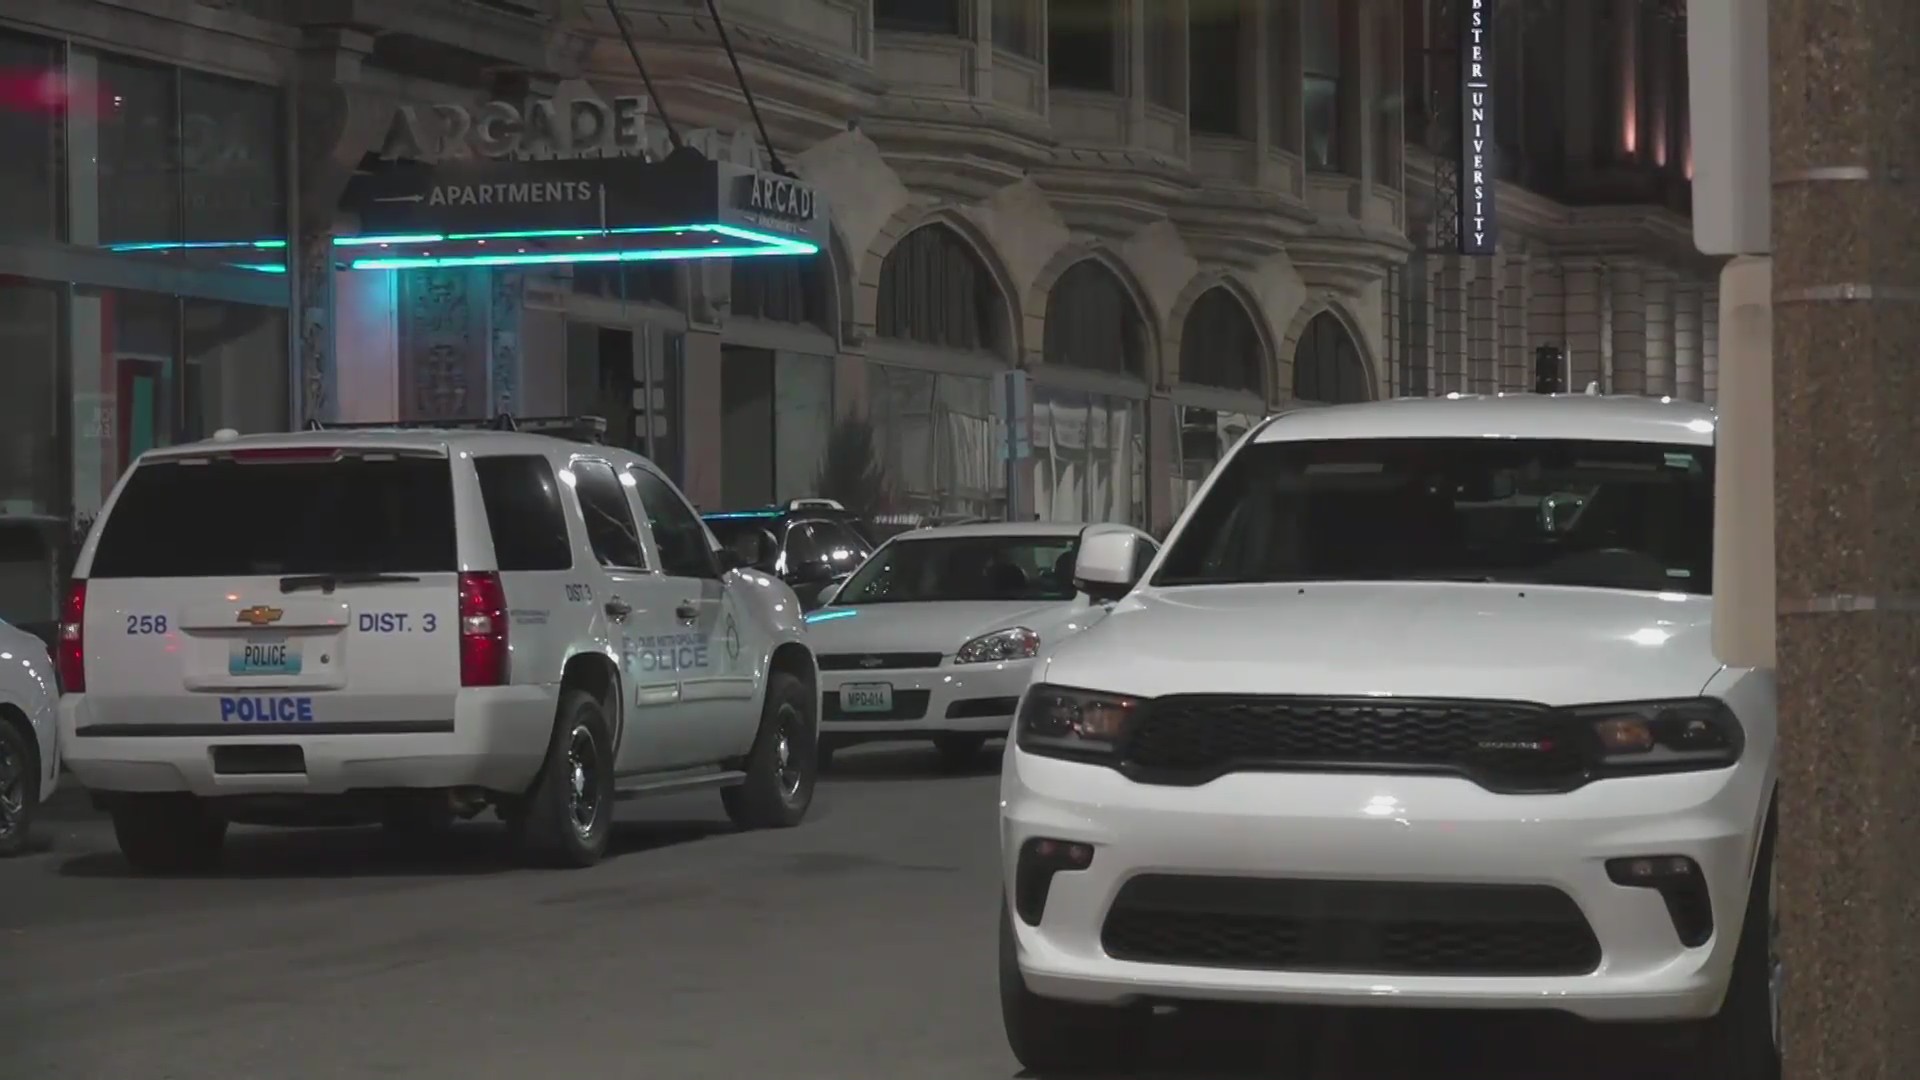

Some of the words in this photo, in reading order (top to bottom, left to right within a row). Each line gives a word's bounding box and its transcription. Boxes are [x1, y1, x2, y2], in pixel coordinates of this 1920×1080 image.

[380, 95, 647, 159] ARCADE
[1472, 92, 1485, 247] UNIVERSITY
[430, 181, 592, 206] APARTMENTS
[126, 615, 167, 635] 258
[359, 613, 412, 633] DIST.
[422, 613, 437, 633] 3
[244, 645, 286, 666] POLICE
[623, 646, 708, 674] POLICE
[220, 697, 313, 723] POLICE
